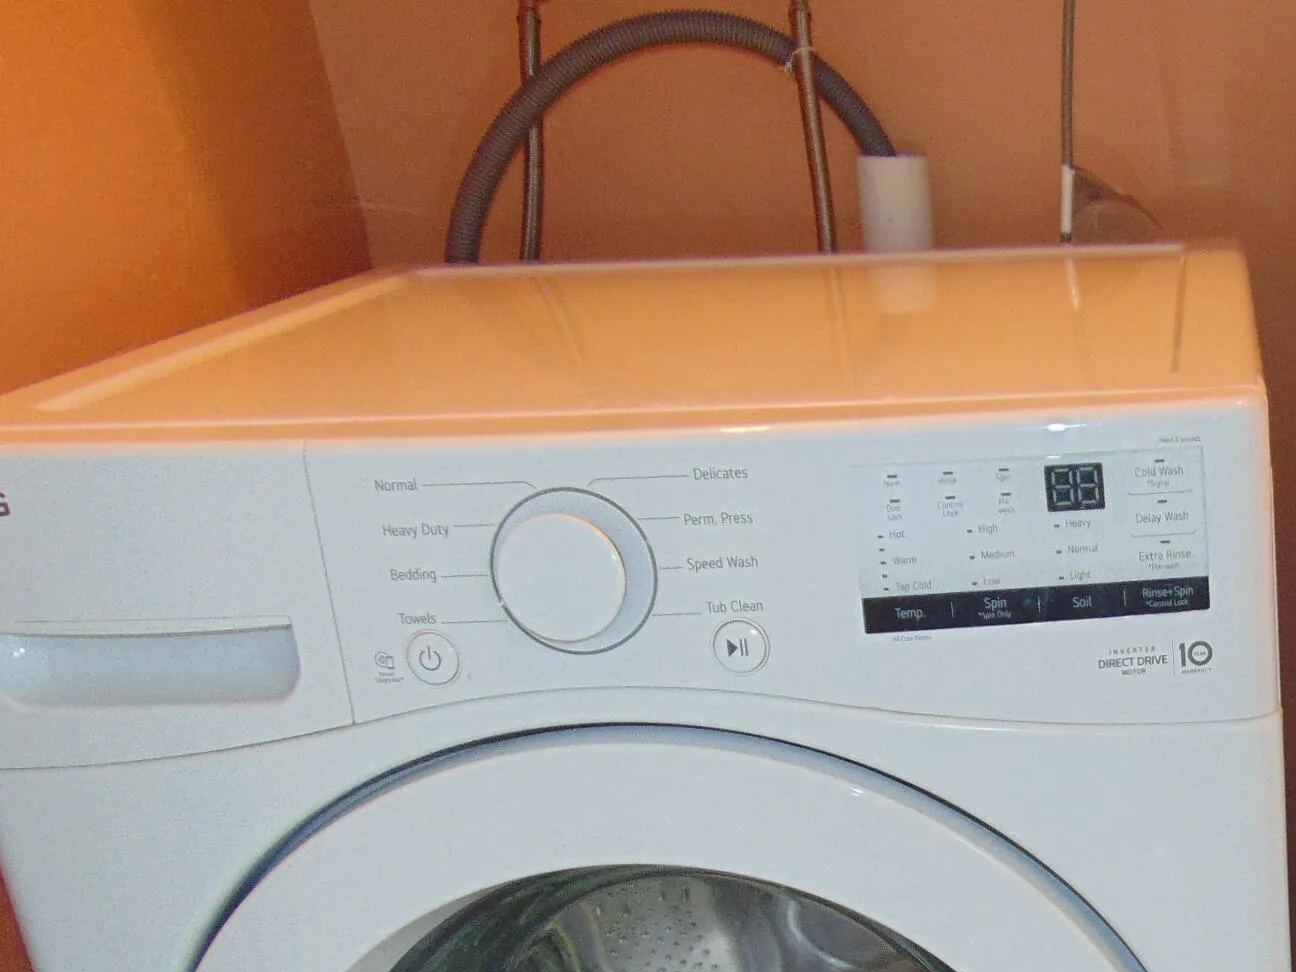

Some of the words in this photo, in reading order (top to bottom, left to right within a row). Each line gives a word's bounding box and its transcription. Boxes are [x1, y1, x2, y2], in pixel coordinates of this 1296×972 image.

[693, 467, 748, 481] Delicates
[1134, 465, 1158, 478] Cold
[1159, 463, 1184, 477] Wash
[374, 478, 418, 492] Normal
[683, 513, 717, 526] Perm.
[720, 511, 753, 524] Press
[1064, 517, 1091, 530] Heavy
[1135, 511, 1162, 526] Delay
[1164, 510, 1190, 522] Wash
[382, 525, 418, 539] Heavy
[421, 522, 449, 537] Duty
[977, 522, 998, 536] High
[981, 549, 1015, 560] Medium
[1067, 544, 1099, 555] Normal
[1138, 549, 1164, 563] Extra
[1166, 549, 1192, 561] Rinse
[687, 556, 723, 572] Speed
[727, 554, 759, 569] Wash
[893, 555, 917, 566] Warm
[390, 568, 437, 583] Bedding
[983, 576, 1001, 586] Low
[1069, 570, 1091, 582] Light
[895, 581, 911, 593] Tap
[912, 580, 933, 592] Cold
[1142, 584, 1195, 599] Rinse+Spin
[706, 601, 727, 613] Tub
[730, 599, 763, 613] Clean
[983, 597, 1008, 611] Spin
[1072, 594, 1093, 609] Soil
[398, 611, 437, 625] Towels
[894, 606, 926, 621] Temp.
[1179, 640, 1214, 668] 10
[1097, 656, 1136, 670] DIRECT
[1137, 653, 1169, 667] DRIVE
[1121, 667, 1147, 677] MOTOR
